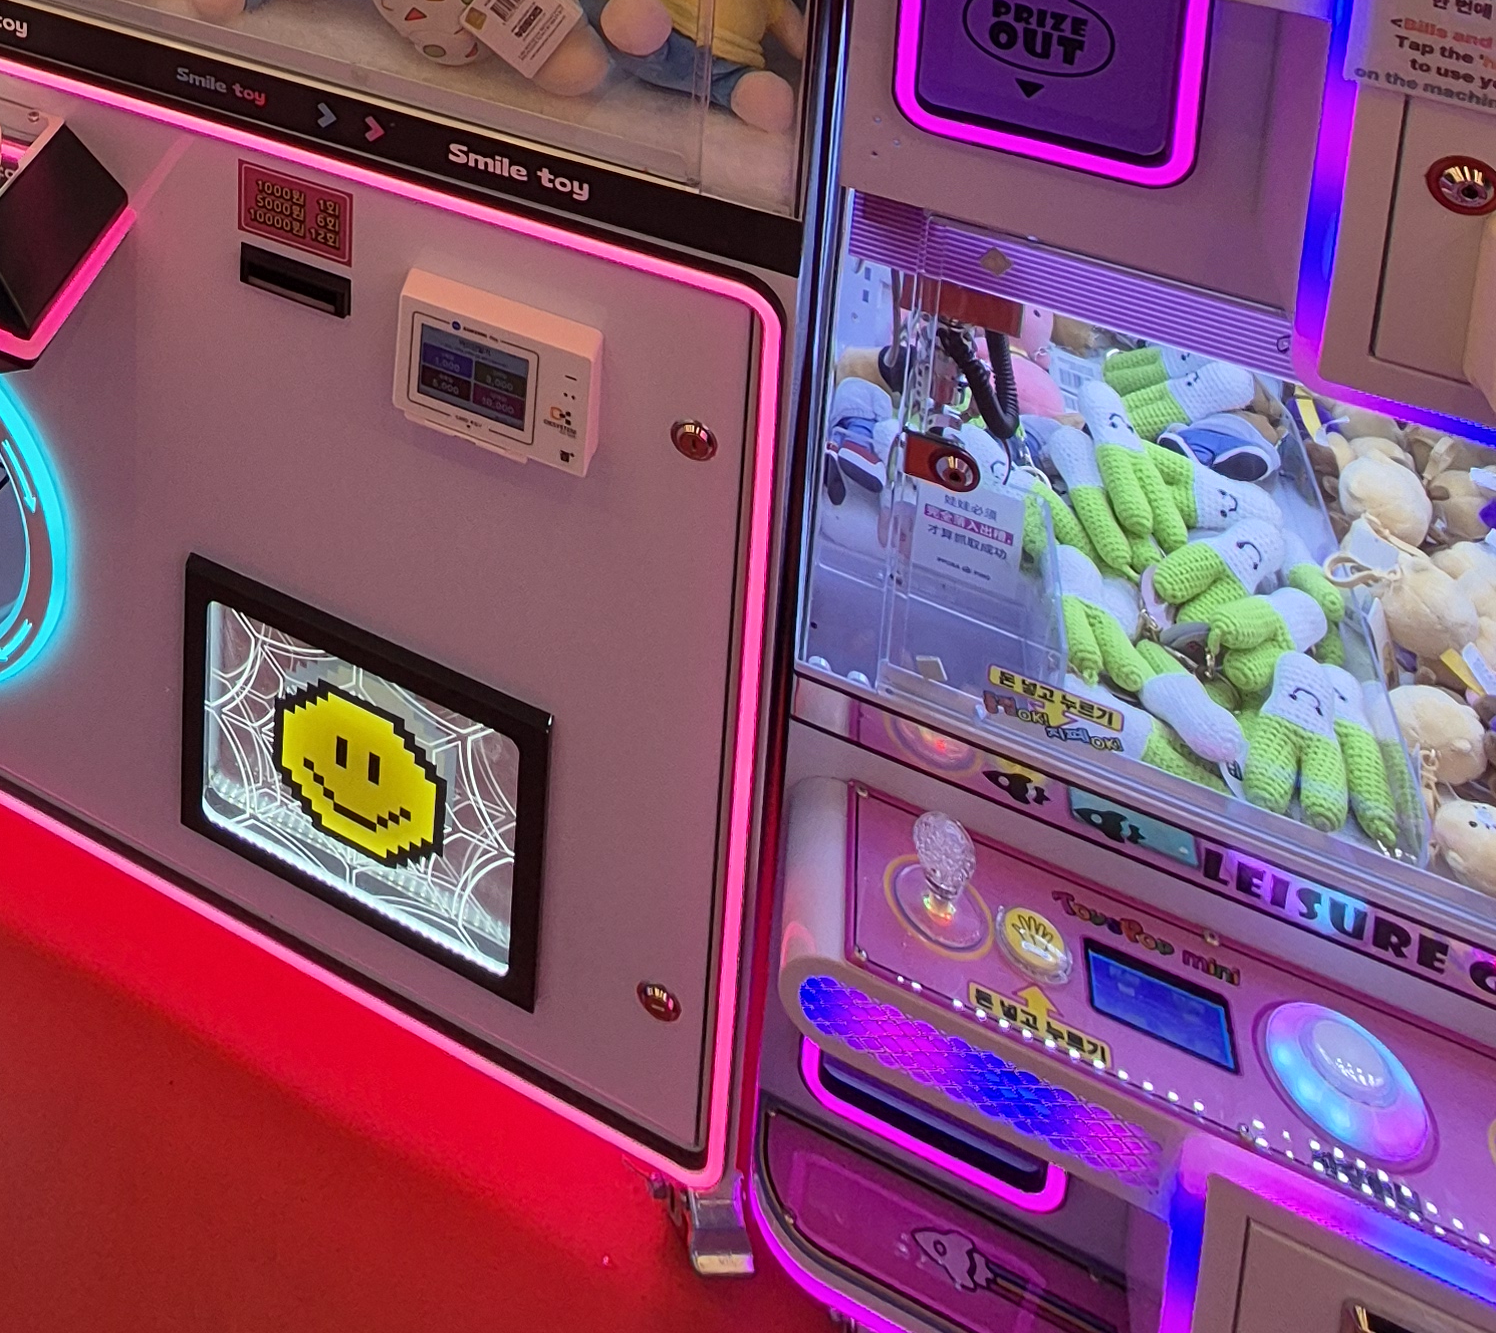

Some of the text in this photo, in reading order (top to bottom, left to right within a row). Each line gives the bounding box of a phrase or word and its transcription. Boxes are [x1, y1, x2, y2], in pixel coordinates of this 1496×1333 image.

[989, 20, 1085, 66] OUT
[1395, 34, 1434, 57] Tap
[1439, 46, 1474, 65] the
[1453, 30, 1493, 50] and
[176, 68, 266, 106] Smile toy
[1354, 67, 1380, 81] on
[1384, 71, 1418, 90] the
[1409, 58, 1432, 73] to
[1436, 66, 1475, 84] use
[448, 143, 591, 202] Smile toy
[256, 180, 340, 216] 1000원 1회
[256, 195, 340, 232] 5000원 6회
[249, 208, 340, 248] 10000원 12회
[999, 670, 1015, 688] 돈
[1060, 694, 1113, 727] 누르기
[1204, 847, 1450, 975] LEISURE
[1183, 949, 1241, 986] mini
[974, 988, 993, 1009] 돈
